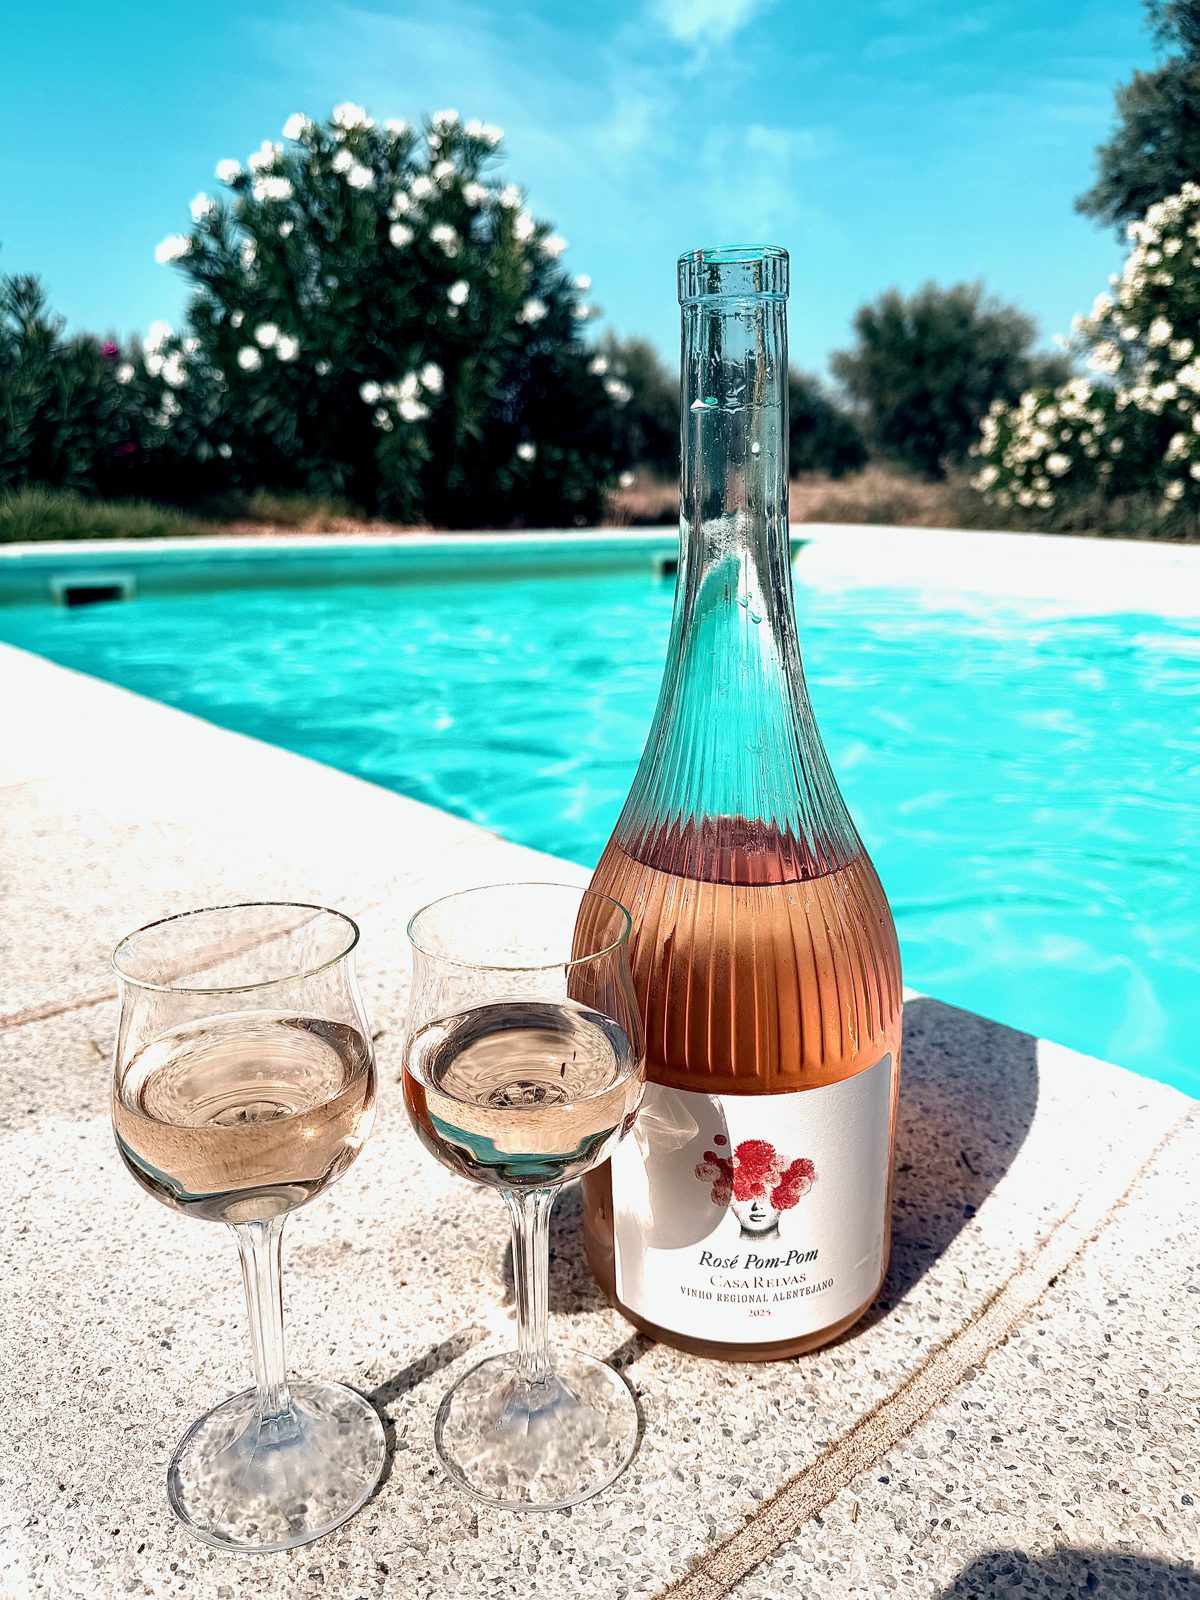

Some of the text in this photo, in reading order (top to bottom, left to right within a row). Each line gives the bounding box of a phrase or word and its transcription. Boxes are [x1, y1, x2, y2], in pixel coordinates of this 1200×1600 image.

[699, 1248, 819, 1270] Rosé Pom-Pom
[680, 1277, 835, 1303] VINHO REGIONAL ALENTEJANO
[710, 1272, 807, 1289] CASA RELVAS
